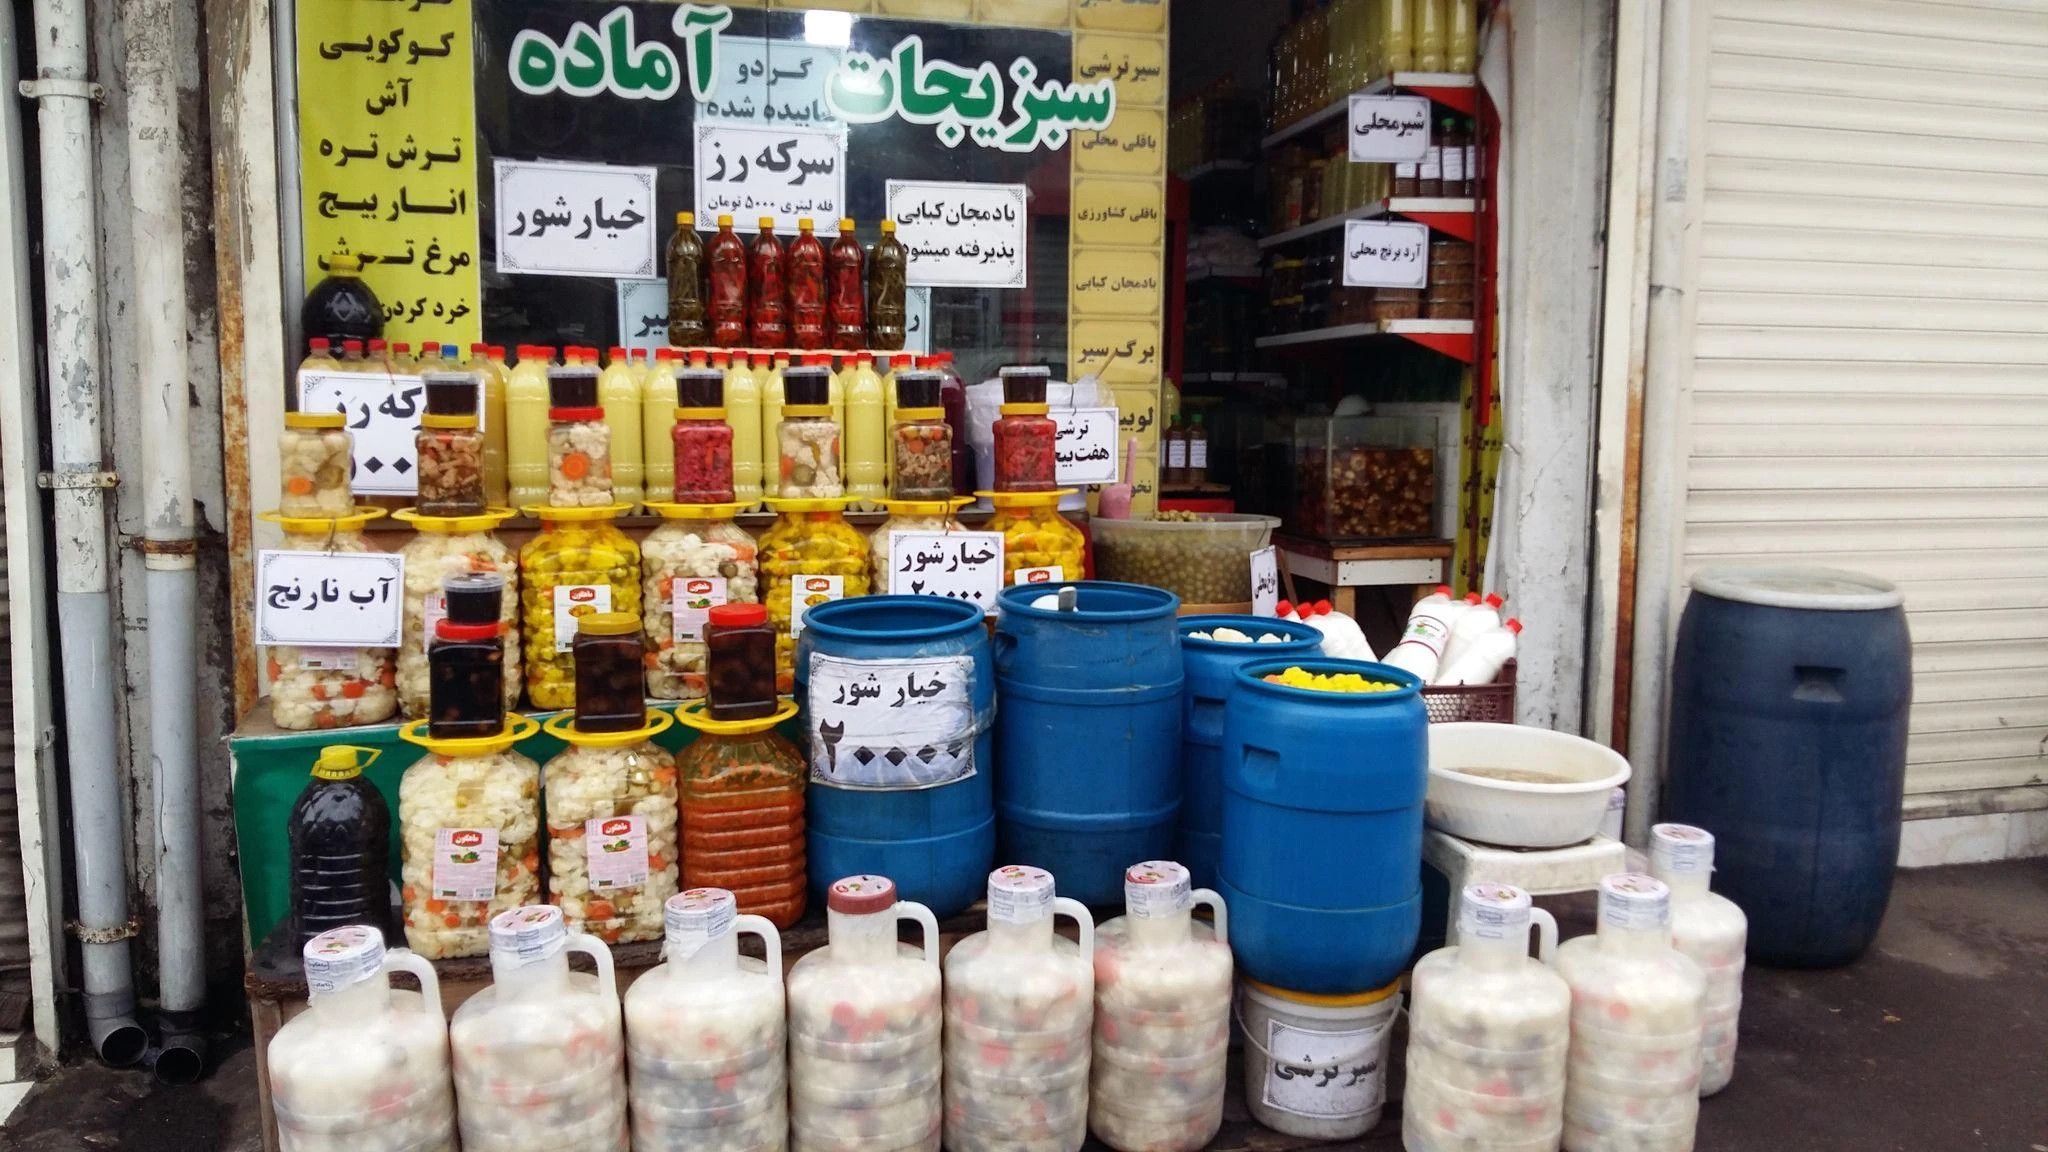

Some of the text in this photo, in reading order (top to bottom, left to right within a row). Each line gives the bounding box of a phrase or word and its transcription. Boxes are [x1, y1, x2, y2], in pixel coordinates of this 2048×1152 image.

[511, 5, 1114, 151] سبزیجات آماده
[736, 57, 813, 87] گردو
[365, 77, 413, 116] آش
[706, 95, 756, 121] شده
[319, 132, 461, 171] ترش تره
[1081, 131, 1118, 150] محلی
[706, 139, 834, 185] سرکه رز
[708, 195, 742, 212] تومان
[780, 199, 813, 214] لیتری
[816, 201, 833, 212] فله
[897, 201, 1015, 227] بادمجان کبابی
[1077, 207, 1126, 222] کشاورزی
[318, 236, 471, 275] مرغ ترش
[955, 239, 1015, 266] پذیرفته
[1350, 242, 1377, 260] محلی
[1075, 276, 1156, 293] بادمجان کبابی
[380, 297, 471, 325] خرد کردن
[1077, 338, 1155, 365] برگ سیر
[1055, 419, 1090, 441] ترشی
[1119, 406, 1154, 433] لوبی
[267, 577, 396, 611] آب نارنج
[832, 669, 948, 708] خیار شور
[818, 717, 965, 774] ۲۰۰۰۰
[1274, 1054, 1377, 1089] سیر ترشی
